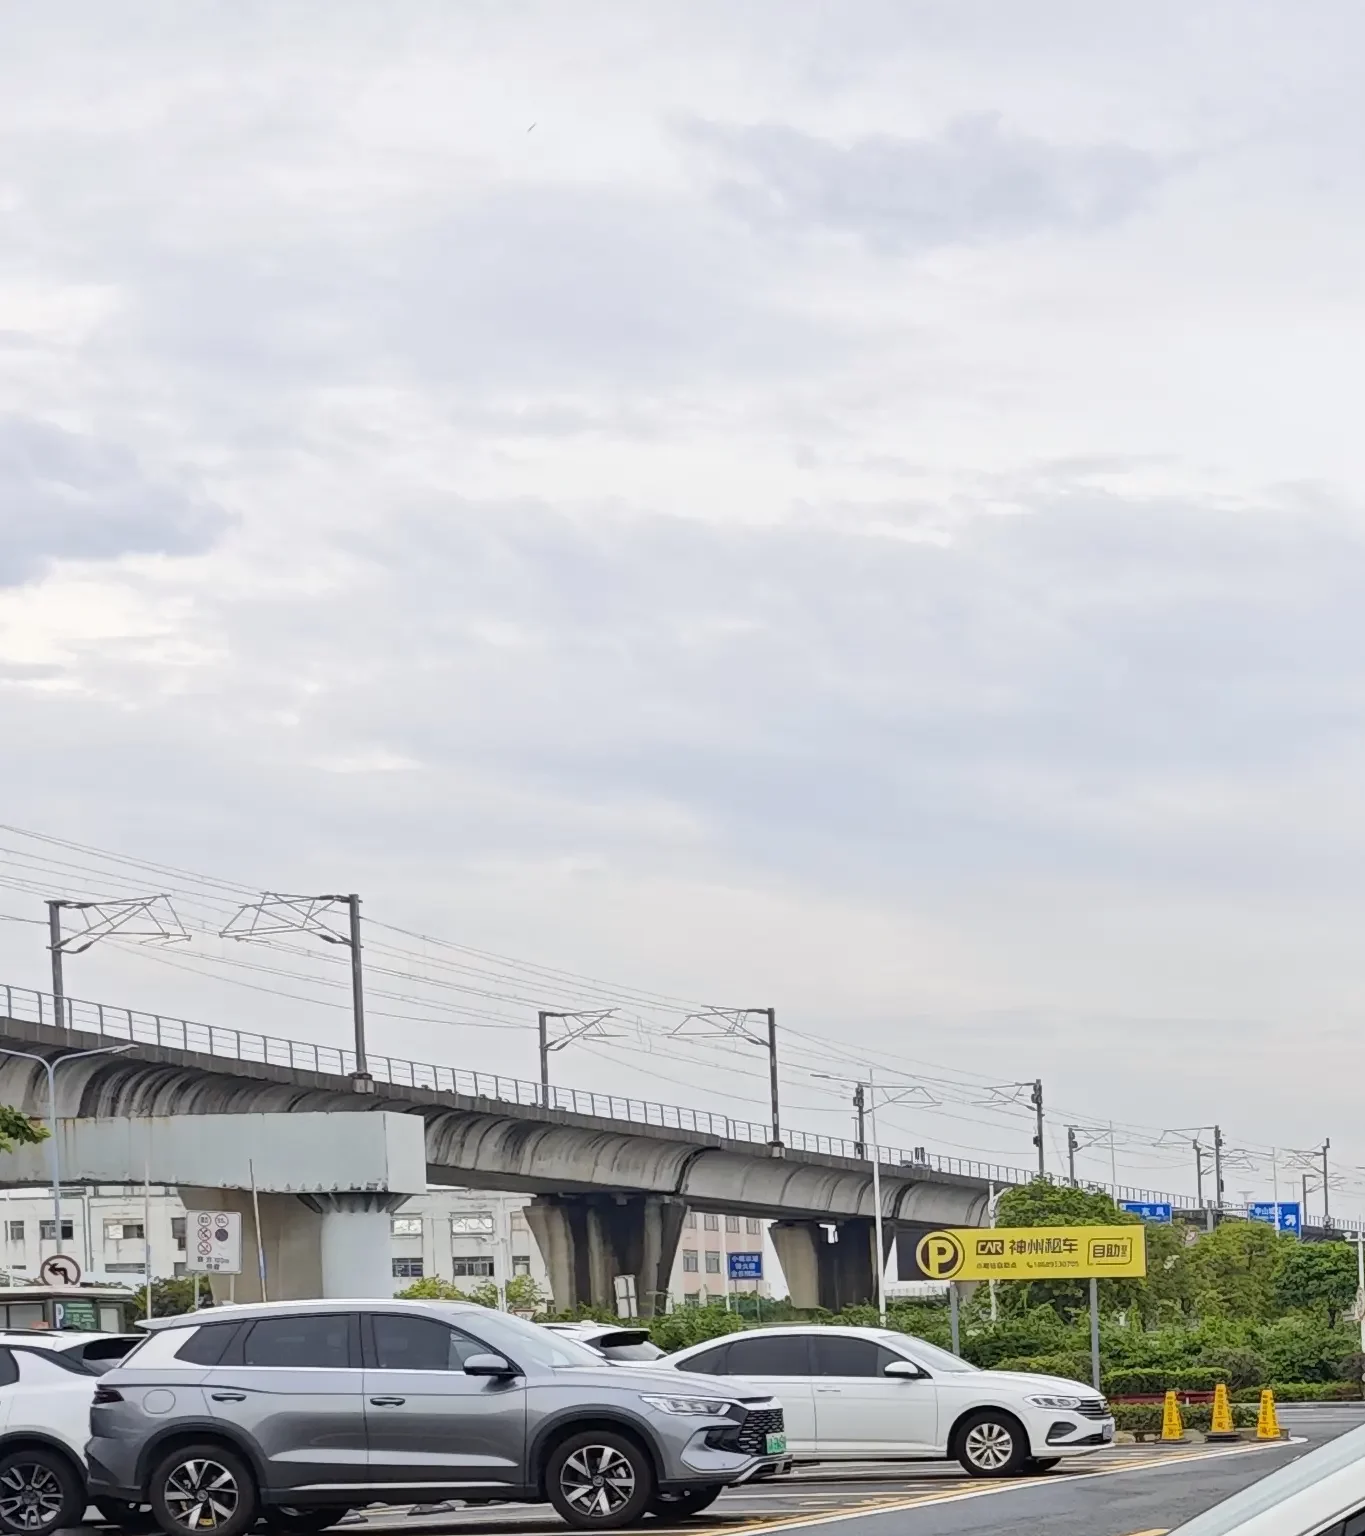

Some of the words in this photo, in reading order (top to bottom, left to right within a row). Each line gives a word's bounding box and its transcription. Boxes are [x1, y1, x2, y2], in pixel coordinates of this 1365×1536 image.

[928, 1239, 956, 1275] P
[979, 1241, 1003, 1254] CAR
[1009, 1239, 1078, 1254] 神州租车
